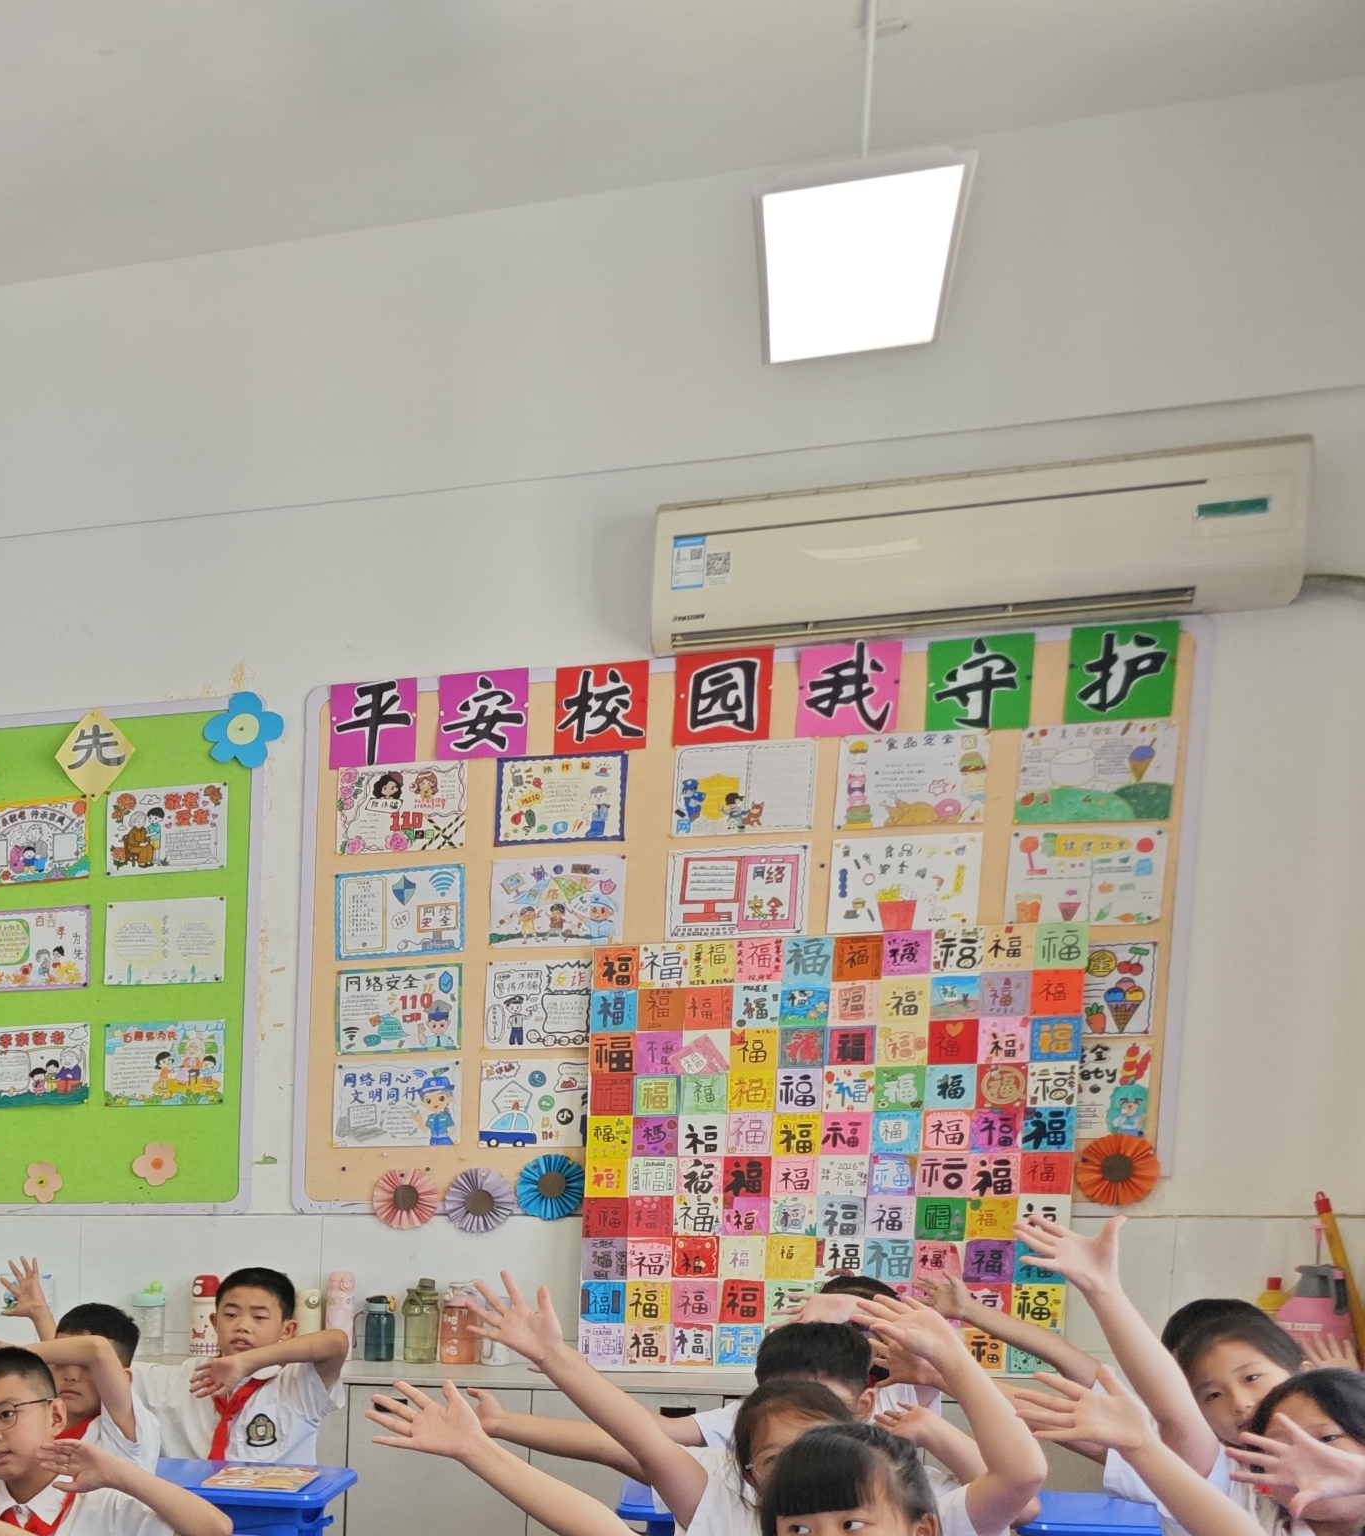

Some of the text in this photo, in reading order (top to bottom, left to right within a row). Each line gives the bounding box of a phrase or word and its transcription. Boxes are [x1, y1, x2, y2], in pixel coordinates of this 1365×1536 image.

[335, 632, 1168, 766] 平安校园我守护
[885, 733, 954, 753] 食品安全
[164, 791, 200, 810] 敬老
[175, 808, 210, 827] 爱老
[390, 812, 423, 831] 110
[885, 843, 914, 859] 食品
[1062, 838, 1127, 854] 健康饮食
[752, 865, 786, 885] 网络
[878, 860, 910, 876] 安全
[421, 915, 452, 929] 安全
[422, 904, 453, 918] 网络
[707, 944, 726, 967] 福
[747, 939, 773, 968] 福
[786, 938, 831, 977] 福
[845, 946, 869, 968] 福
[889, 943, 918, 966] 福
[939, 937, 977, 969] 福
[988, 936, 1022, 959] 福
[1042, 930, 1082, 963] 福
[602, 956, 630, 986] 福
[644, 952, 683, 980] 福
[344, 973, 422, 993] 网络安全
[1039, 981, 1066, 1002] 福
[399, 992, 434, 1010] 110
[596, 991, 625, 1028] 福
[646, 995, 671, 1022] 福
[688, 999, 713, 1020] 福
[743, 996, 768, 1020] 福
[788, 989, 813, 1007] 福
[840, 991, 866, 1013] 福
[891, 991, 918, 1016] 福
[739, 1039, 767, 1064] 福
[785, 1032, 821, 1063] 福
[887, 1036, 914, 1059] 福
[989, 1033, 1016, 1058] 福
[1038, 1023, 1073, 1055] 福
[594, 1036, 632, 1073] 福
[683, 1051, 705, 1072] 福
[343, 1071, 412, 1088] 网络同心
[730, 1077, 767, 1106] 福
[779, 1074, 816, 1107] 福
[884, 1074, 917, 1103] 福
[937, 1073, 966, 1100] 福
[987, 1070, 1016, 1098] 福
[1033, 1069, 1069, 1100] 福
[350, 1086, 420, 1105] 文明同行
[642, 1081, 669, 1109] 福
[694, 1081, 715, 1104] 福
[835, 1078, 868, 1107] 福
[593, 1124, 615, 1143] 福
[685, 1124, 718, 1154] 福
[730, 1117, 767, 1146] 福
[780, 1124, 813, 1154] 福
[822, 1121, 862, 1148] 福
[881, 1121, 903, 1142] 福
[929, 1119, 965, 1146] 福
[981, 1117, 1014, 1147] 福
[1022, 1111, 1066, 1149] 福
[592, 1167, 614, 1188] 福
[684, 1159, 715, 1194] 福
[724, 1161, 762, 1194] 福
[781, 1167, 809, 1191] 福
[837, 1162, 859, 1171] 2026
[875, 1162, 910, 1187] 福
[920, 1158, 967, 1190] 福
[971, 1159, 1012, 1197] 福
[1026, 1162, 1056, 1183] 福
[642, 1167, 666, 1192] 福
[679, 1202, 714, 1233] 福
[733, 1210, 755, 1231] 福
[780, 1207, 800, 1227] 福
[823, 1202, 859, 1236] 福
[871, 1204, 903, 1232] 福
[925, 1205, 950, 1230] 福
[976, 1209, 997, 1226] 福
[633, 1252, 665, 1277] 福
[728, 1249, 750, 1268] 福
[780, 1246, 794, 1260] 福
[828, 1243, 860, 1270] 福
[866, 1240, 912, 1279] 福
[920, 1249, 944, 1267] 福
[589, 1291, 610, 1315] 福
[629, 1288, 659, 1319] 福
[677, 1291, 709, 1315] 福
[726, 1286, 759, 1318] 福
[1017, 1290, 1051, 1321] 福
[630, 1333, 659, 1358] 福
[675, 1330, 704, 1355] 福
[970, 1335, 999, 1363] 福
